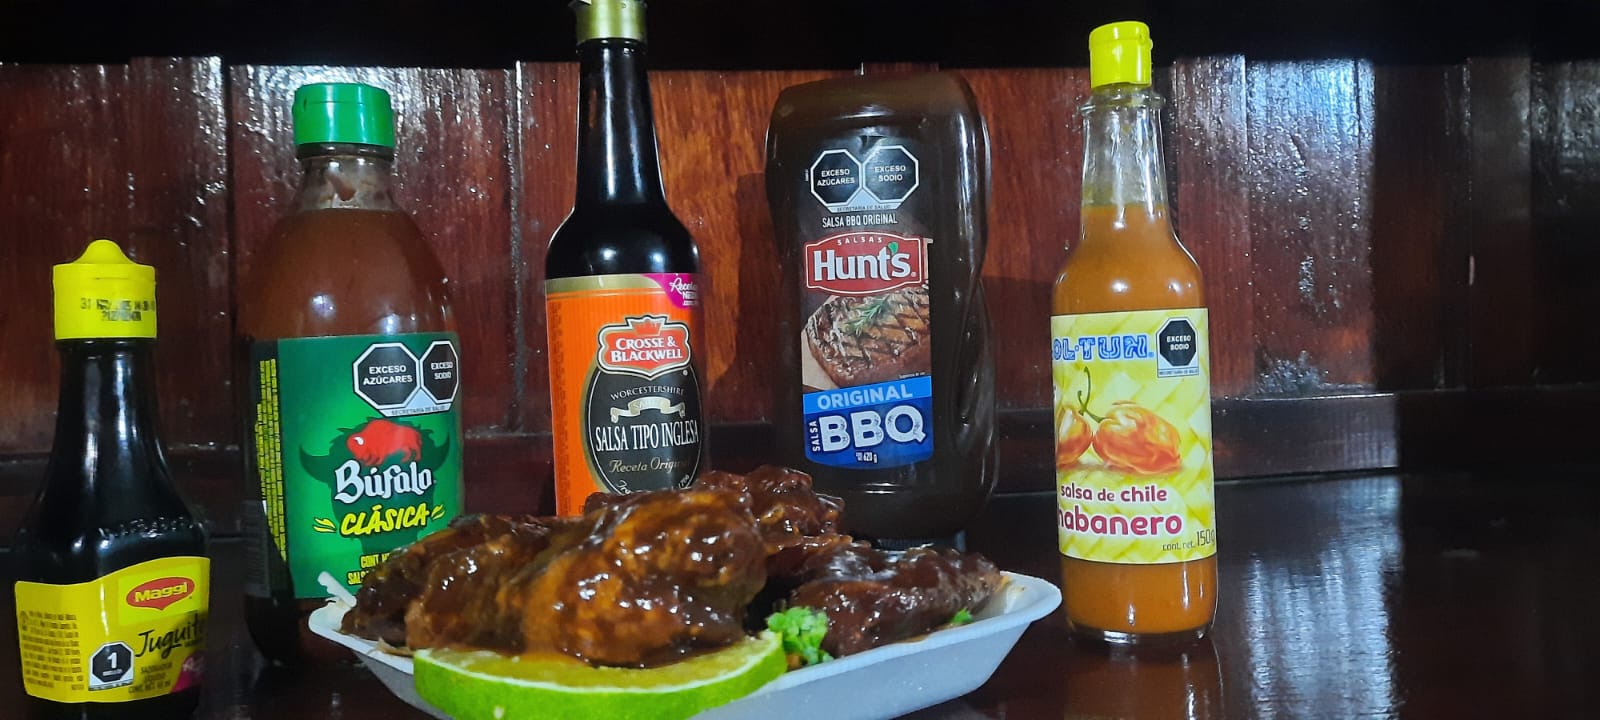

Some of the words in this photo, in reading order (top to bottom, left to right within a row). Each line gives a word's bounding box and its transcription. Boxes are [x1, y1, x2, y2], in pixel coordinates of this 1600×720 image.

[821, 168, 850, 178] EXCESO
[874, 164, 906, 173] EXCESO
[817, 177, 855, 187] AZÚCARES
[878, 174, 903, 182] SODIO
[822, 216, 845, 228] SALSA
[846, 214, 861, 226] BBQ
[863, 213, 898, 226] ORIGINAL
[837, 236, 883, 246] SALSAS
[615, 337, 666, 351] CROSSE
[666, 335, 678, 348] &
[1166, 334, 1192, 343] EXCESO
[1170, 343, 1190, 351] SODIO
[611, 348, 683, 363] BLACKWELL
[369, 365, 407, 375] EXCESO
[431, 361, 453, 370] EXCESO
[363, 374, 413, 386] AZÚCARES
[434, 371, 452, 380] SODIO
[610, 385, 685, 401] WORCESTERSHIRE
[817, 383, 913, 410] ORIGINAL
[595, 425, 629, 452] SALSA
[630, 423, 659, 450] TIPO
[661, 419, 699, 448] INGLESA
[809, 420, 821, 452] SALSA
[818, 405, 926, 452] BBQ
[608, 459, 648, 473] Receta
[334, 459, 432, 504] Búfalo
[1061, 483, 1092, 500] salsa
[1097, 488, 1115, 502] de
[1120, 485, 1167, 502] chile
[340, 503, 430, 536] CLÁSICA
[134, 582, 188, 603] Maggi
[107, 652, 117, 669] 1
